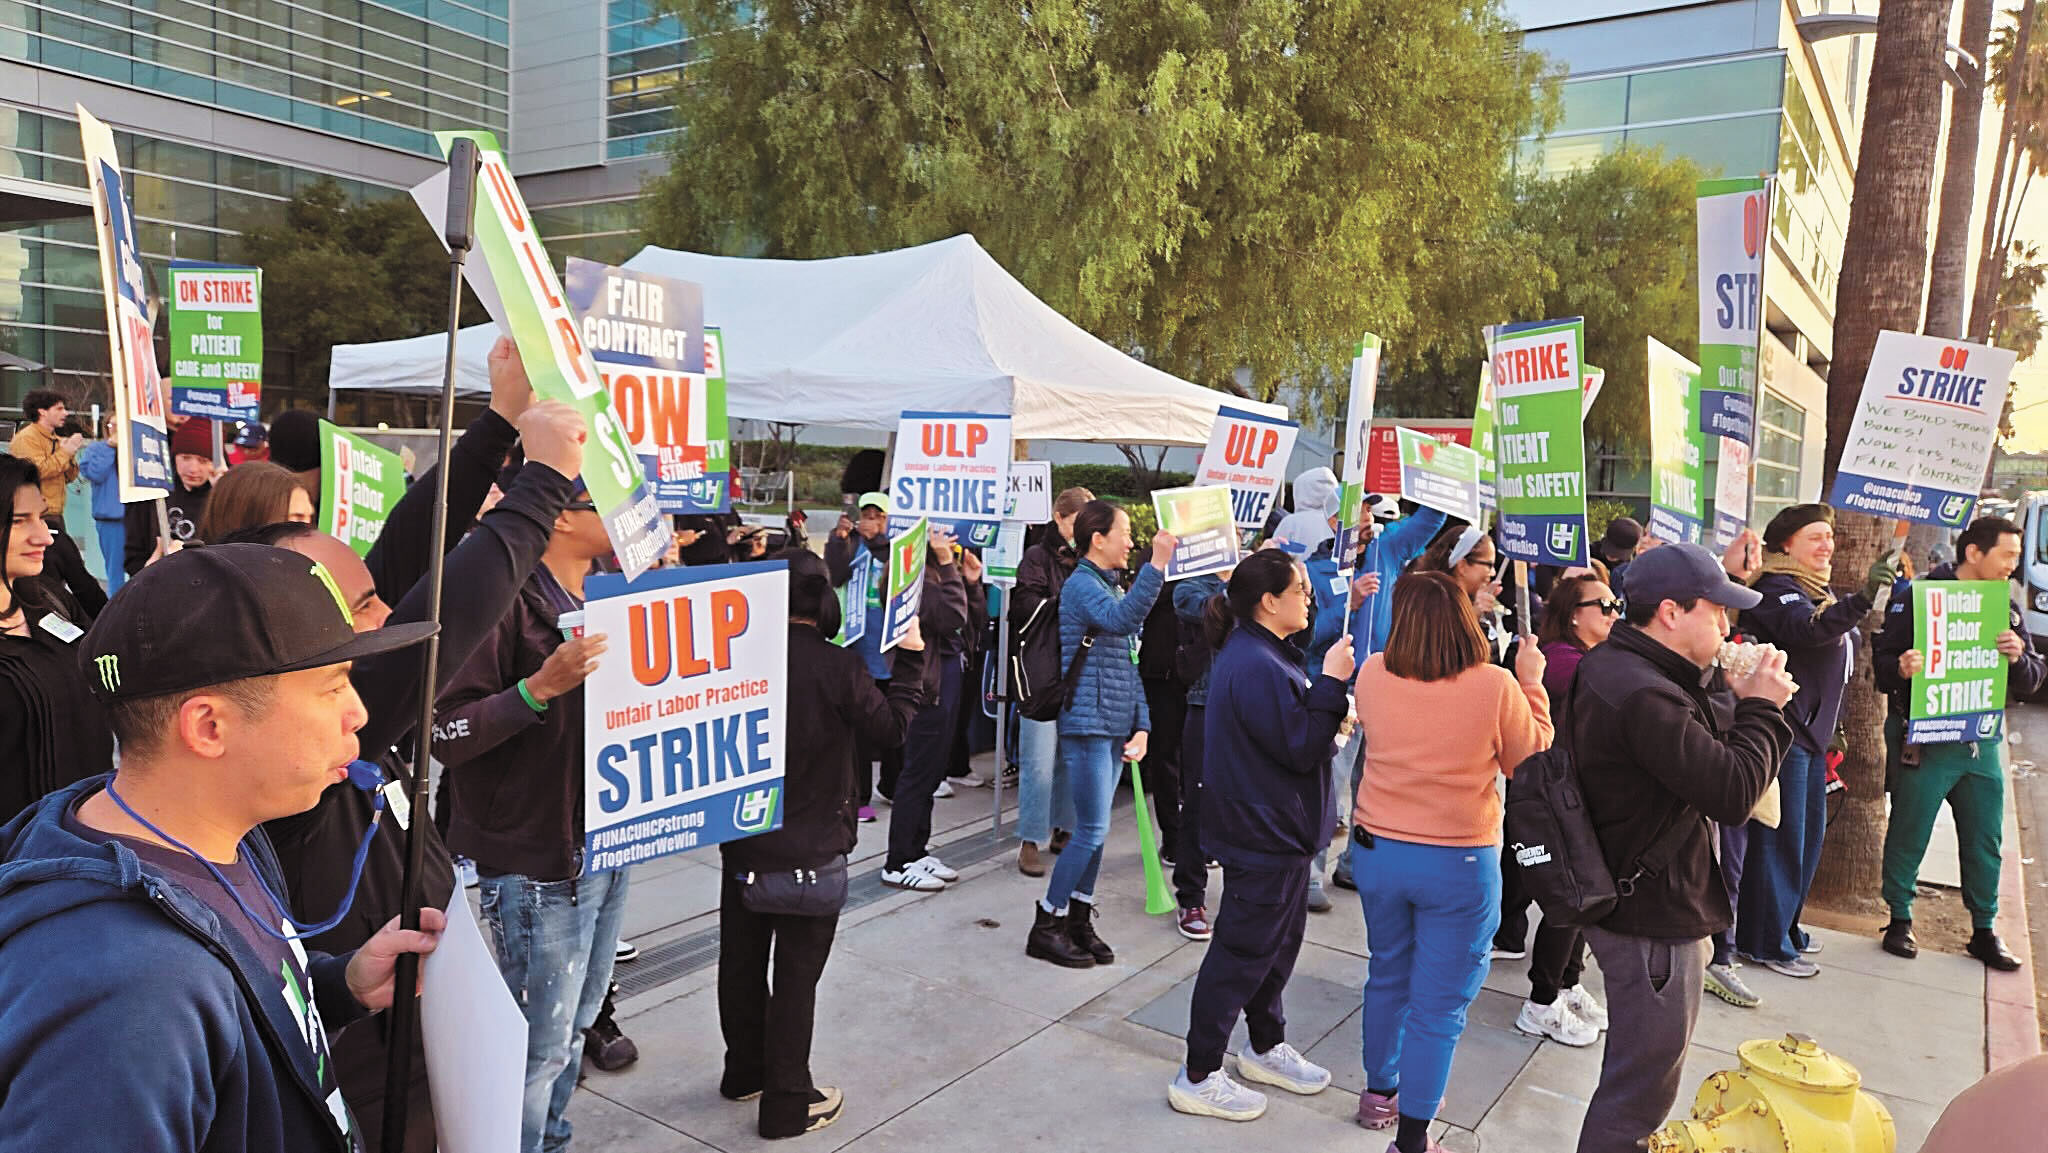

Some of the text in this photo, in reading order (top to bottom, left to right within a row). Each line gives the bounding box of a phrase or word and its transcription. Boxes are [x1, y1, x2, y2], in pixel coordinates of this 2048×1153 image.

[180, 279, 253, 304] ON STRIKE
[607, 275, 665, 323] FAIR
[1715, 273, 1757, 331] STR
[206, 313, 223, 330] for
[583, 315, 687, 361] CONTRACT
[191, 334, 242, 357] PATIENT
[1494, 341, 1570, 387] STRIKE
[1939, 346, 1969, 372] ON
[175, 360, 260, 380] CARE and SAFETY
[1898, 366, 1987, 407] STRIKE
[1502, 402, 1520, 426] for
[659, 445, 682, 464] ULP
[922, 423, 988, 458] ULP
[1224, 423, 1279, 469] ULP
[660, 460, 704, 482] STRIKE
[1525, 471, 1580, 499] SAFETY
[896, 477, 997, 515] STRIKE
[1231, 488, 1271, 523] RIKE
[1863, 481, 1922, 504] @unacuhcp
[628, 588, 750, 687] ULP
[606, 679, 769, 730] Unfair Labor Practice
[1925, 678, 1993, 716] STRIKE
[596, 707, 772, 814] STRIKE
[592, 810, 705, 851] #UNACUHCPstrong
[591, 831, 698, 872] #TogetherWeWin
